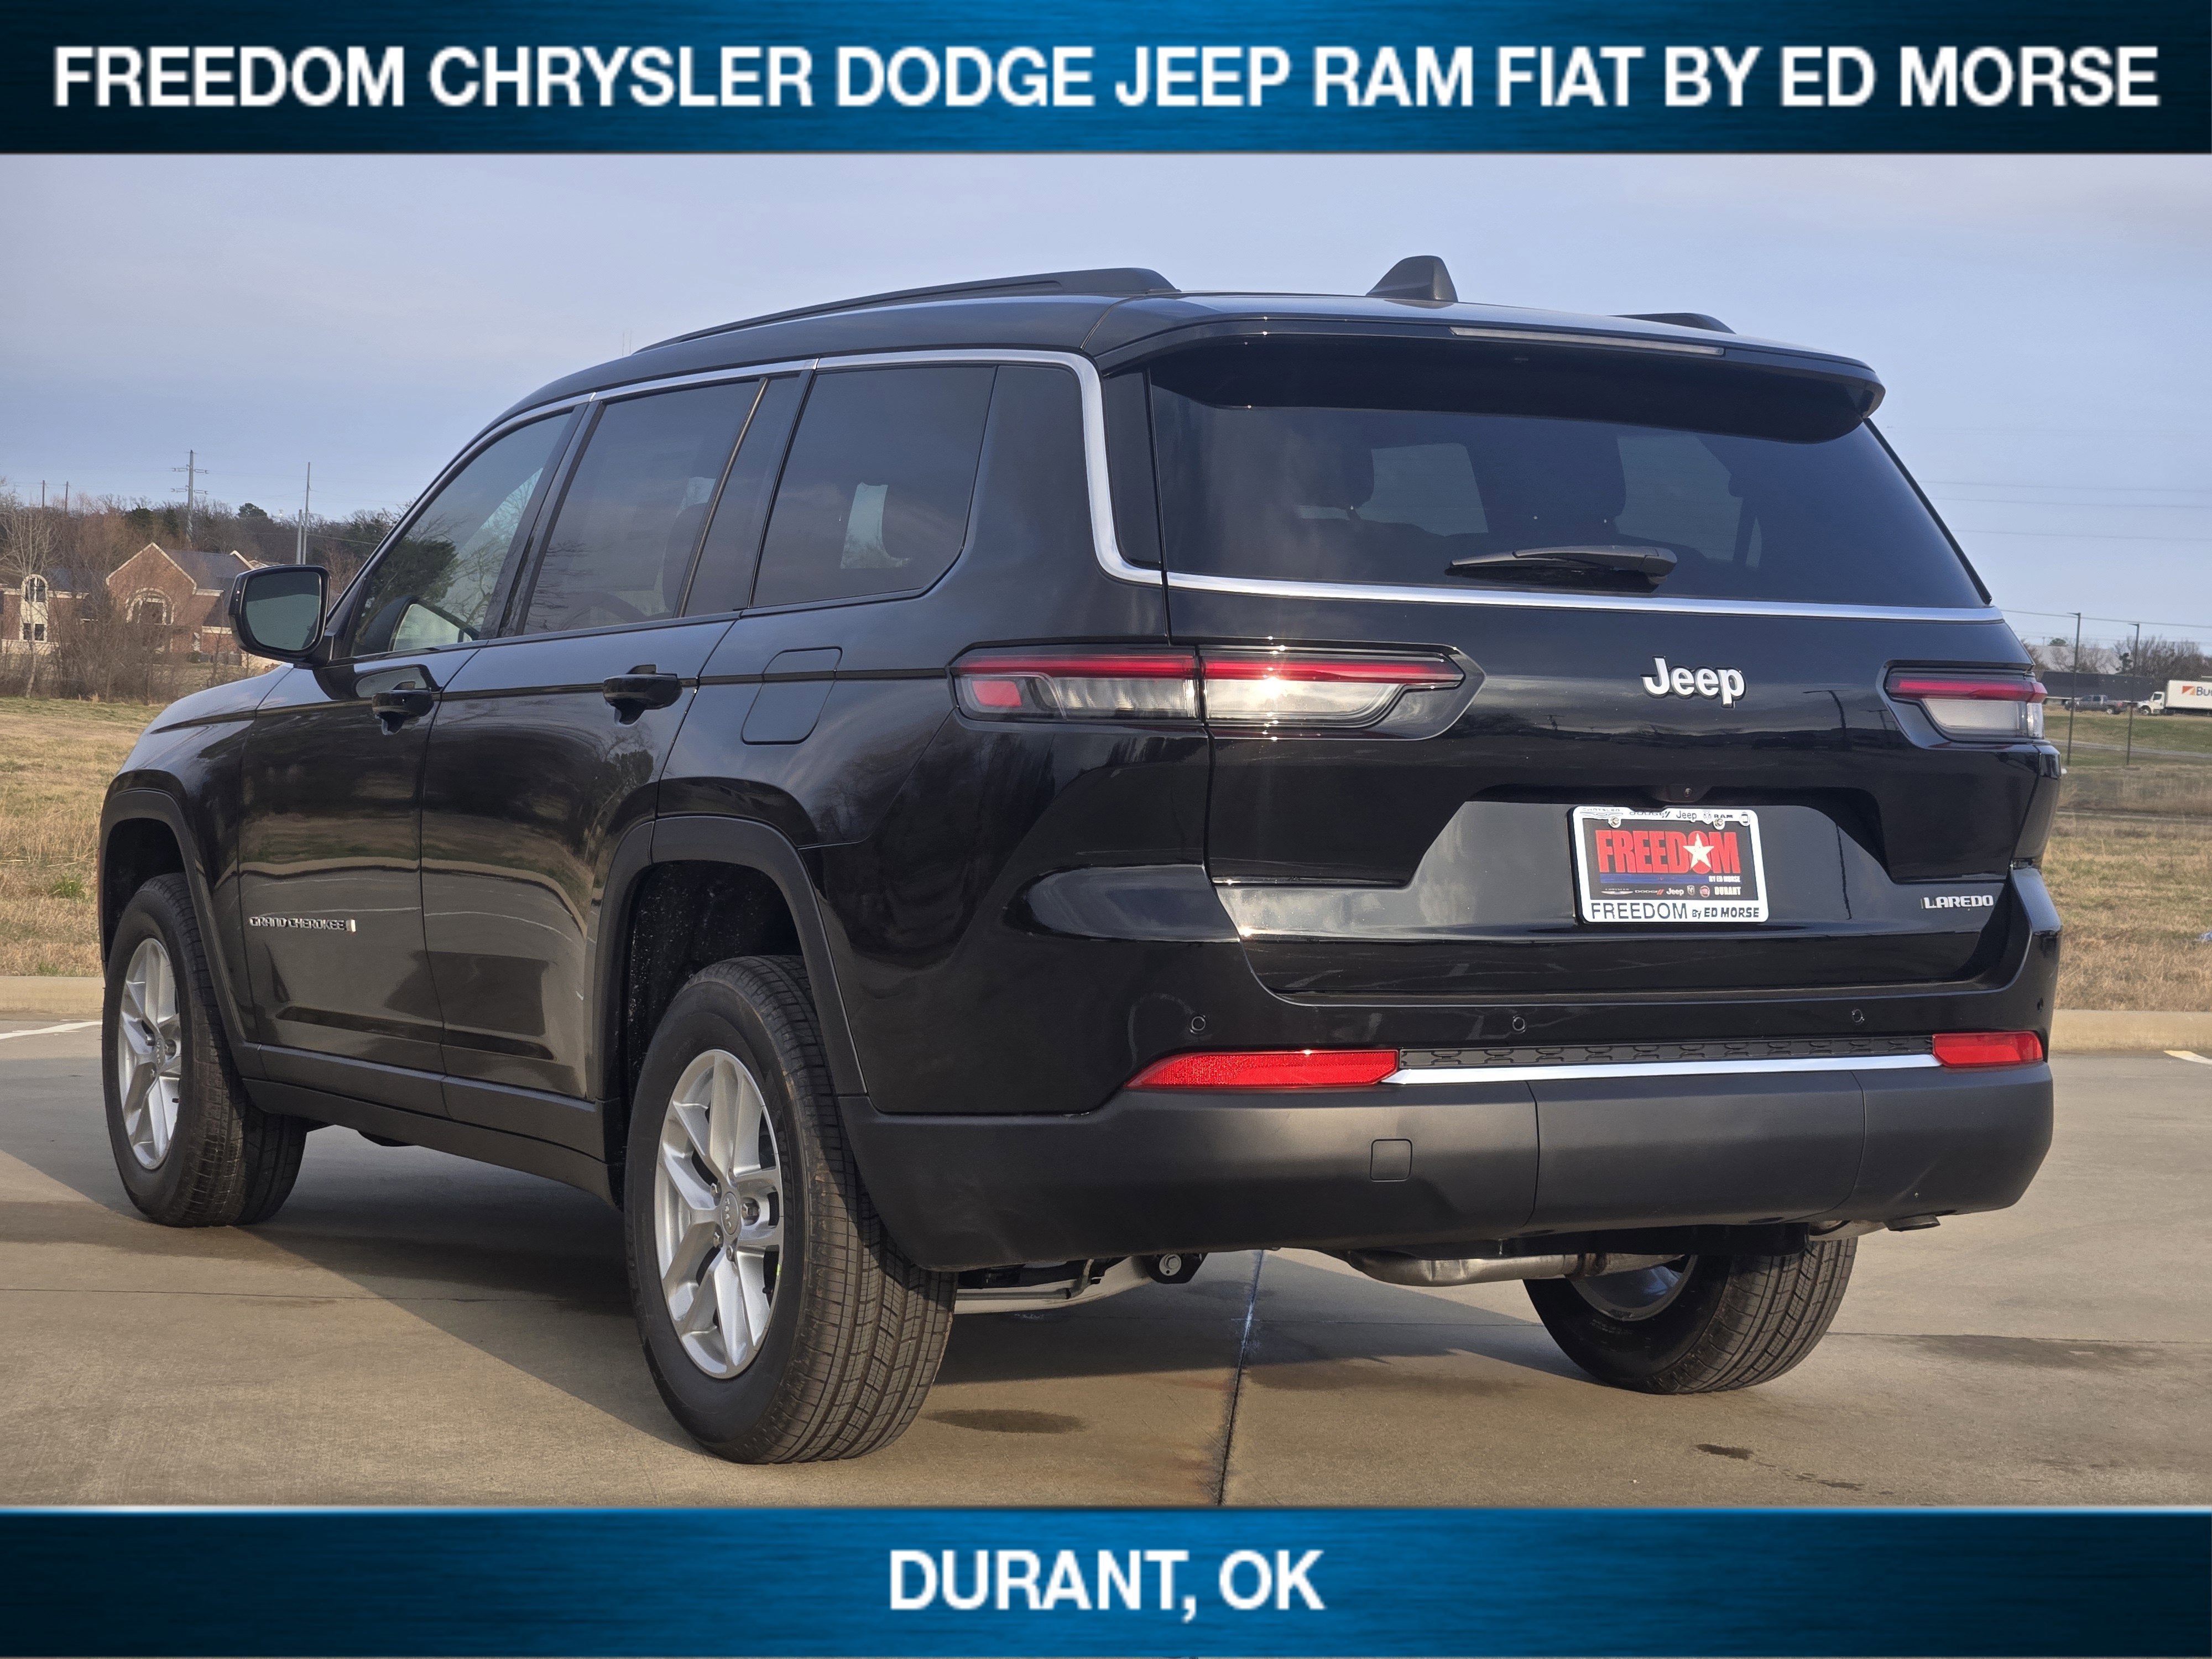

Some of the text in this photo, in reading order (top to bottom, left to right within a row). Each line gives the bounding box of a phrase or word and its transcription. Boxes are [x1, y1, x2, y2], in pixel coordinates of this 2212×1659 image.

[1641, 656, 1745, 706] Jeep
[2196, 686, 2212, 696] Bu
[1676, 810, 1697, 820] Jeep
[1595, 830, 1741, 874] FREEDOM
[1666, 888, 1684, 896] Jeep
[1714, 886, 1741, 895] DURANT
[1923, 895, 1994, 910] LAREDO
[1591, 902, 1688, 919] FREEDOM
[1704, 907, 1718, 917] ED
[1720, 907, 1760, 918] MORSE
[249, 916, 345, 931] GRAND CHEROKEE
